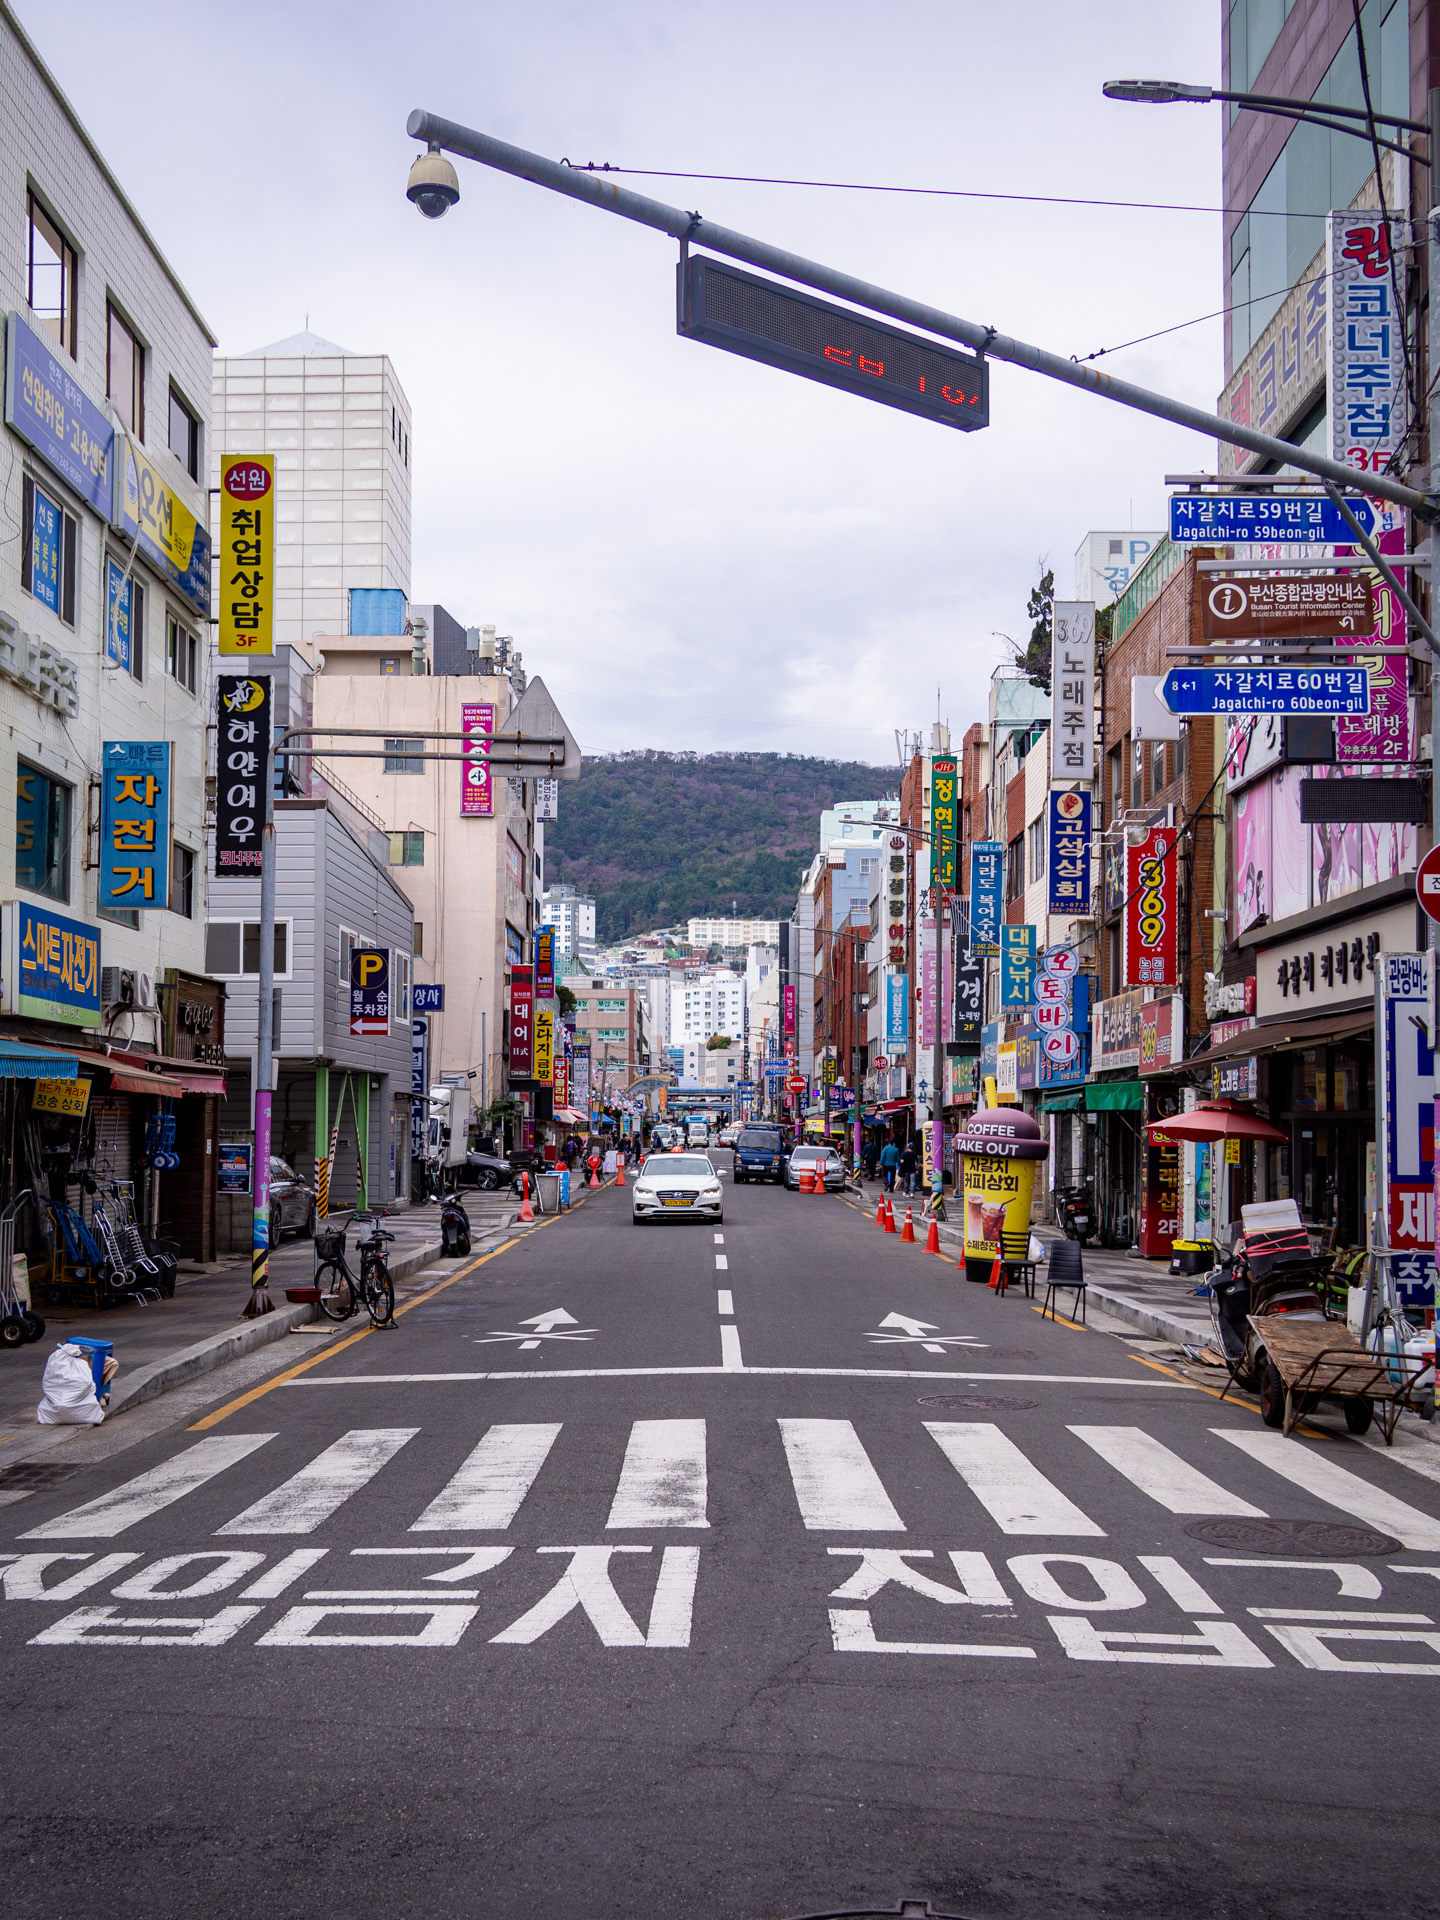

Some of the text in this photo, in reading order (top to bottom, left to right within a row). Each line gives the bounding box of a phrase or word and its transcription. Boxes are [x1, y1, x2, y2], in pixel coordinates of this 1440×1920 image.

[1341, 222, 1391, 278] 퀸
[1345, 284, 1392, 438] 코너주점
[1346, 446, 1392, 473] 3F
[229, 469, 265, 491] 선원
[1175, 501, 1323, 524] 자갈치로59번길
[1175, 525, 1325, 540] Jagalchi-ro 59beon-gil
[1129, 540, 1151, 565] P
[230, 509, 264, 629] 취업상담
[1249, 583, 1367, 603] 부산종합관광안내소
[1250, 603, 1273, 611] Busan
[1056, 612, 1093, 644] 369
[235, 634, 258, 647] 3F
[1213, 673, 1363, 694] 자갈치로60번길
[1061, 652, 1086, 767] 노래주점
[1211, 697, 1364, 712] Jagalchi-ro 60beon-gil
[1342, 714, 1404, 737] 노래방
[108, 743, 164, 762] 스마트
[1343, 740, 1404, 756] 유흥주점 2F
[935, 763, 953, 772] JH
[226, 718, 260, 843] 하얀여우
[110, 775, 161, 900] 자전거
[1055, 819, 1086, 900] 고성상회
[976, 854, 998, 942] 마라도 복어수산
[1138, 858, 1166, 947] 369
[22, 918, 98, 997] 스마트자전거
[1008, 928, 1031, 1002] 대등낚시
[1139, 957, 1164, 969] 노래
[360, 954, 383, 986] P
[1139, 969, 1164, 982] 주점
[1277, 951, 1315, 997] 자갈치
[352, 1003, 388, 1017] 주차장
[1038, 952, 1073, 1055] 오토바이
[514, 1003, 529, 1041] 대어
[958, 1011, 981, 1021] 노래방
[963, 1023, 975, 1031] 2F
[1103, 1001, 1132, 1043] 고성상회
[1142, 1021, 1157, 1064] 369
[62, 1098, 84, 1113] 상회
[967, 1123, 1015, 1138] COFFEE
[956, 1138, 1019, 1157] TAKE OUT
[969, 1157, 1009, 1175] 자갈치
[964, 1173, 1019, 1192] 커피상회
[826, 1548, 1440, 1676] 진입금
